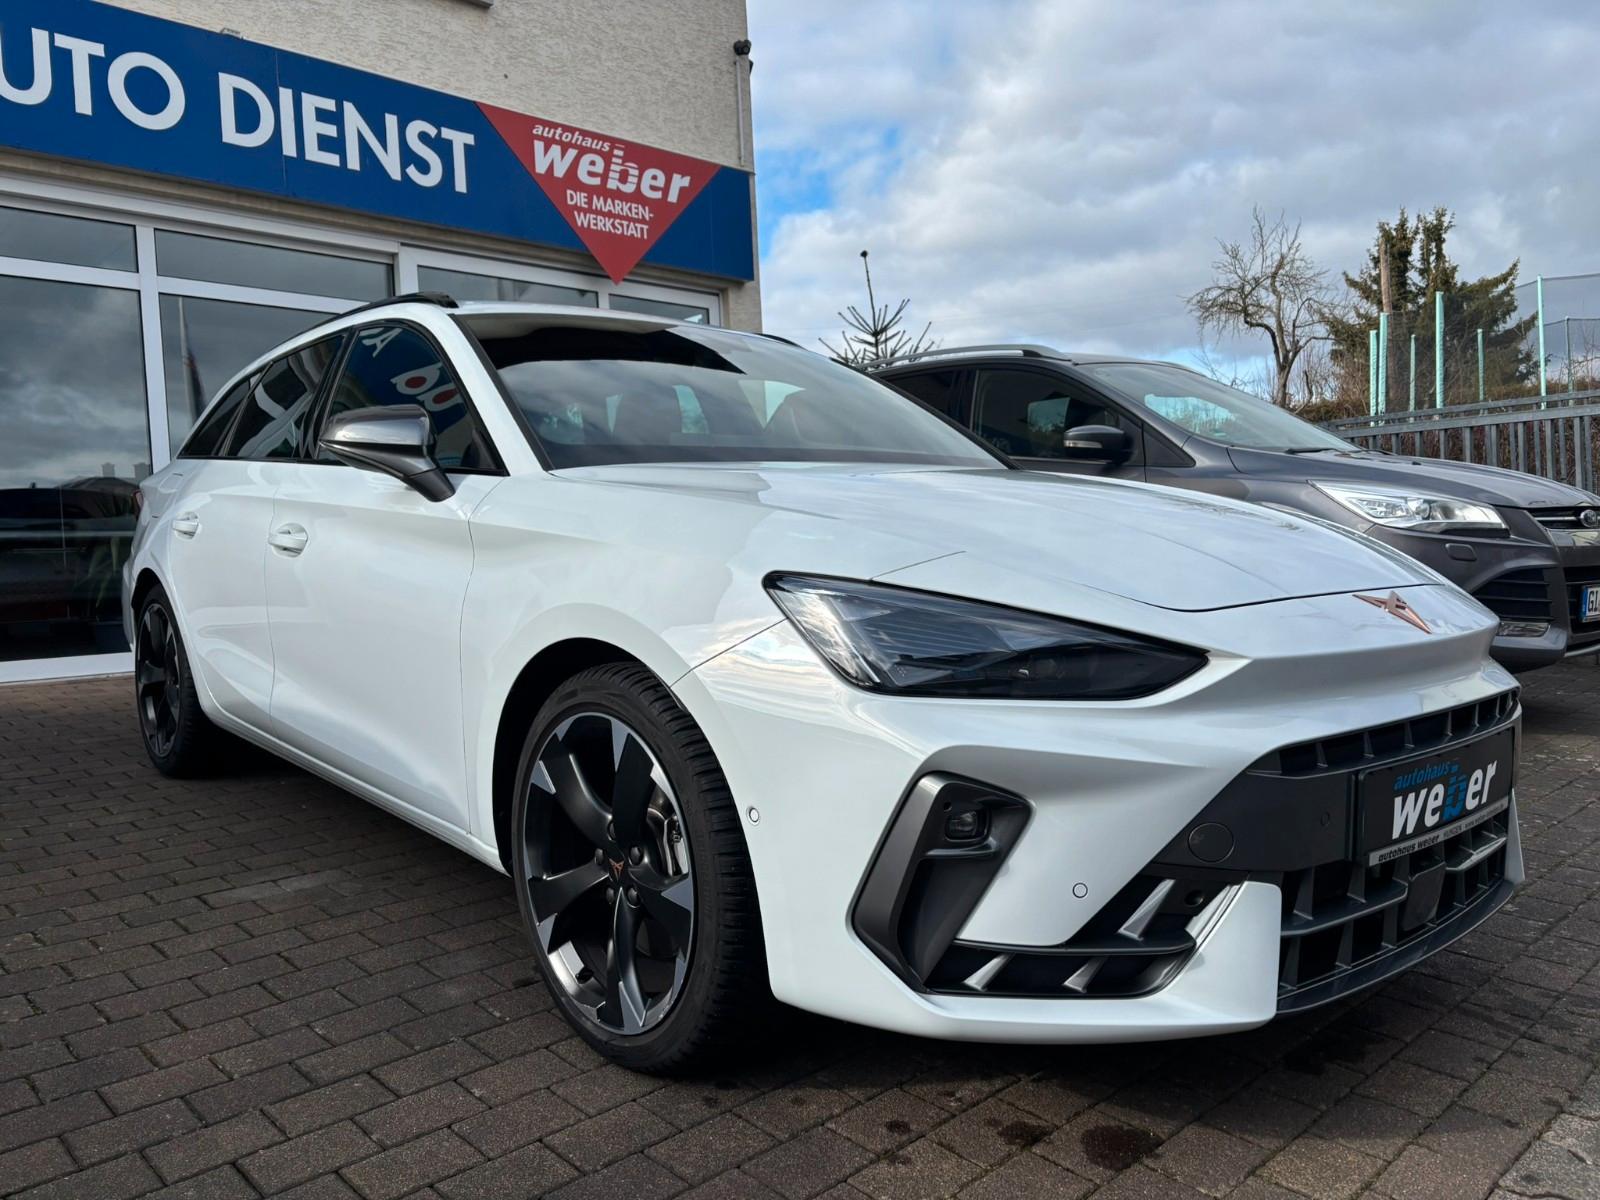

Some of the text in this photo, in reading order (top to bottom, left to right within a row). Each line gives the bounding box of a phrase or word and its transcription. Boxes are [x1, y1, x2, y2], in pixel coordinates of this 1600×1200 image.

[218, 71, 475, 194] DIENST
[532, 124, 611, 152] autohaus
[533, 139, 691, 204] weber
[566, 189, 654, 221] DIE MARKEN-
[574, 211, 649, 240] WERKSTATT
[1393, 761, 1450, 791] autohaus
[1392, 760, 1498, 840] weber
